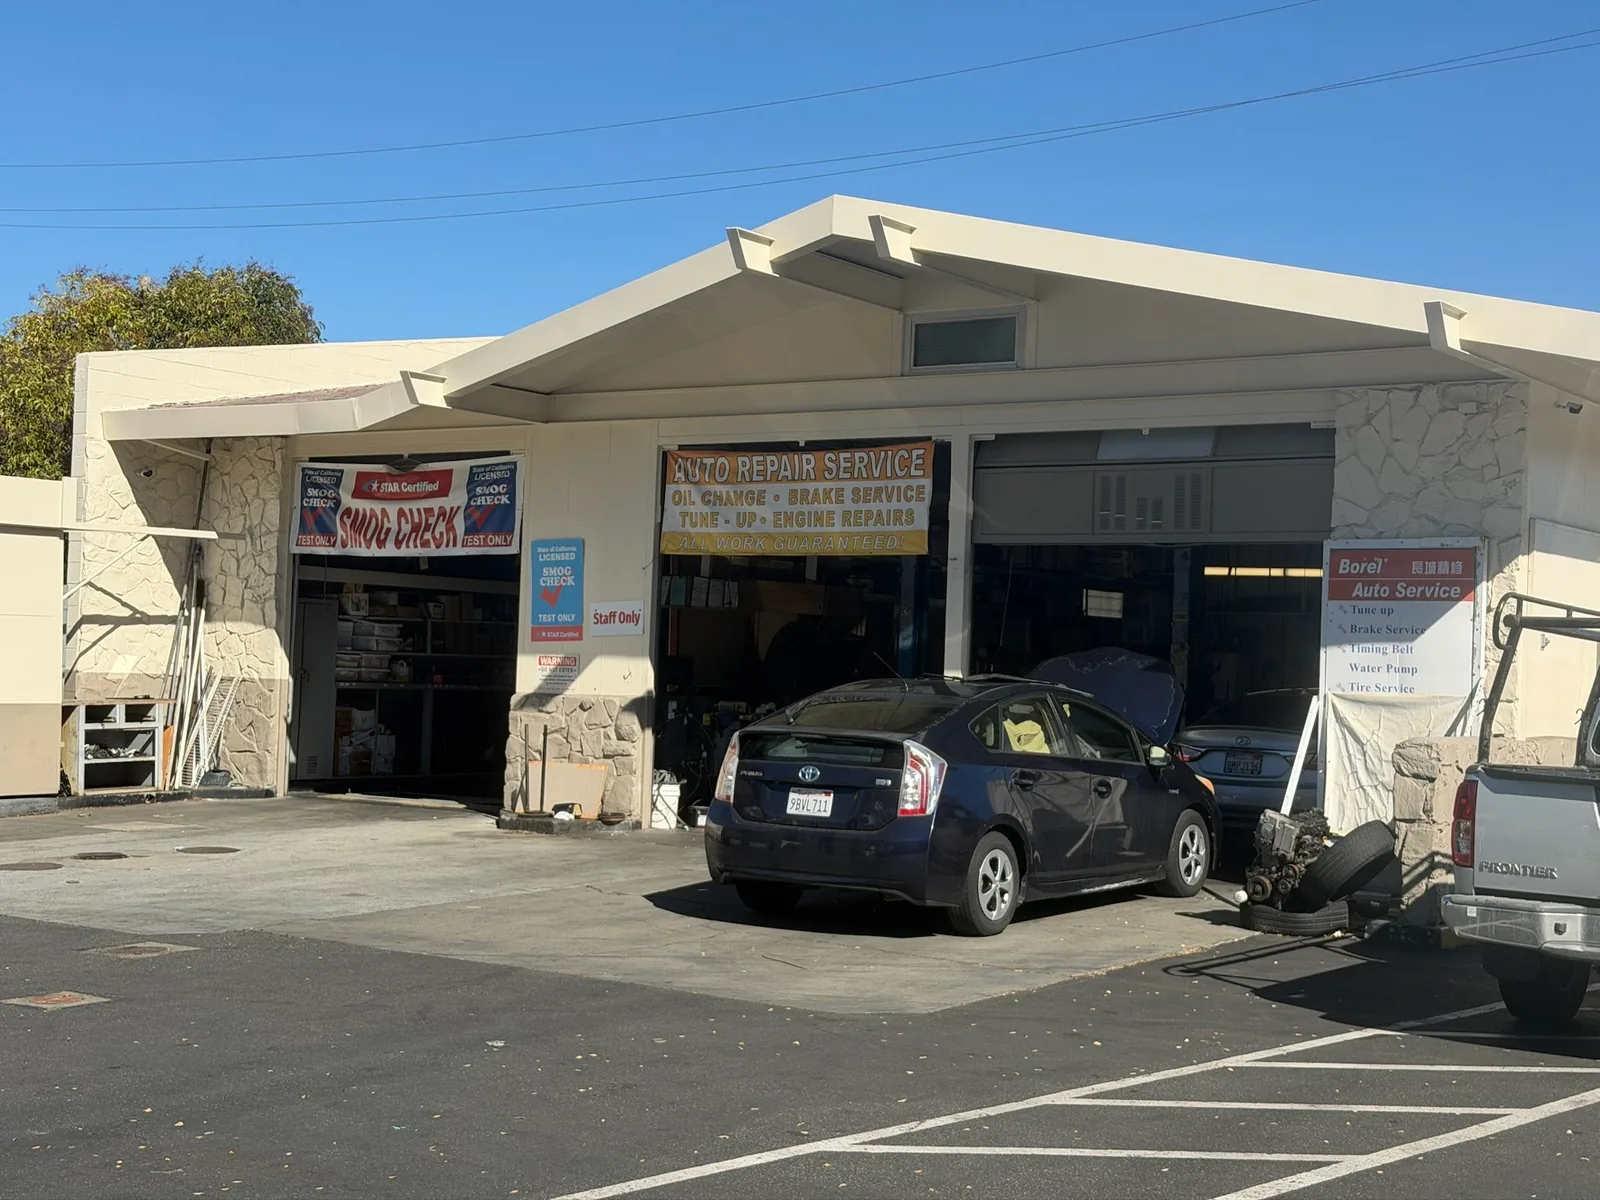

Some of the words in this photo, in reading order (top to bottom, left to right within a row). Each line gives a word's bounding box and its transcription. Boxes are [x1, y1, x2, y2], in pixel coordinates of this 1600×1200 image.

[673, 456, 730, 484] AUTO
[736, 452, 817, 483] REPAIR
[823, 448, 926, 481] SERVICE
[305, 475, 337, 484] LICENSED
[474, 470, 510, 480] LICENSED
[306, 487, 336, 498] SMOG
[379, 481, 400, 493] STAR
[401, 480, 439, 492] Certified
[475, 484, 508, 496] SMOG
[470, 494, 511, 506] CHECK
[671, 489, 696, 507] OIL
[700, 489, 767, 507] CHANGE
[788, 487, 845, 506] BRAKE
[851, 484, 926, 505] SERVICE
[302, 498, 337, 508] CHECK
[679, 511, 720, 528] TUNE
[735, 511, 757, 529] UP
[772, 510, 836, 529] ENGINE
[841, 507, 915, 527] REPAIRS
[339, 506, 392, 550] SMOG
[394, 505, 462, 549] CHECK
[298, 535, 316, 546] TEST
[315, 535, 336, 546] ONLY
[463, 535, 486, 546] TEST
[487, 534, 513, 546] ONLY
[677, 536, 709, 551] ALL
[716, 536, 767, 551] WORK
[772, 534, 905, 551] GUARANTEED!
[539, 552, 576, 561] LICENSED
[543, 566, 572, 577] SMOG
[1338, 558, 1383, 575] Borel
[540, 576, 576, 586] CHECK
[1352, 582, 1390, 598] Auto
[1395, 582, 1461, 598] Service
[1350, 604, 1377, 616] Tune
[1380, 606, 1394, 617] up
[538, 613, 556, 622] TEST
[557, 613, 576, 622] ONLY
[593, 611, 618, 626] Staff
[618, 611, 641, 627] Only
[1350, 624, 1382, 635] Brake
[1385, 624, 1426, 635] Service
[1349, 643, 1388, 656] Timing
[1392, 644, 1414, 655] Belt
[540, 656, 576, 666] WARNING
[1349, 662, 1383, 674] Water
[1386, 663, 1418, 676] Pump
[1348, 682, 1372, 693] Tire
[1374, 682, 1415, 694] Service
[789, 797, 828, 813] 9BVL711
[1479, 860, 1558, 880] FRONTIER
